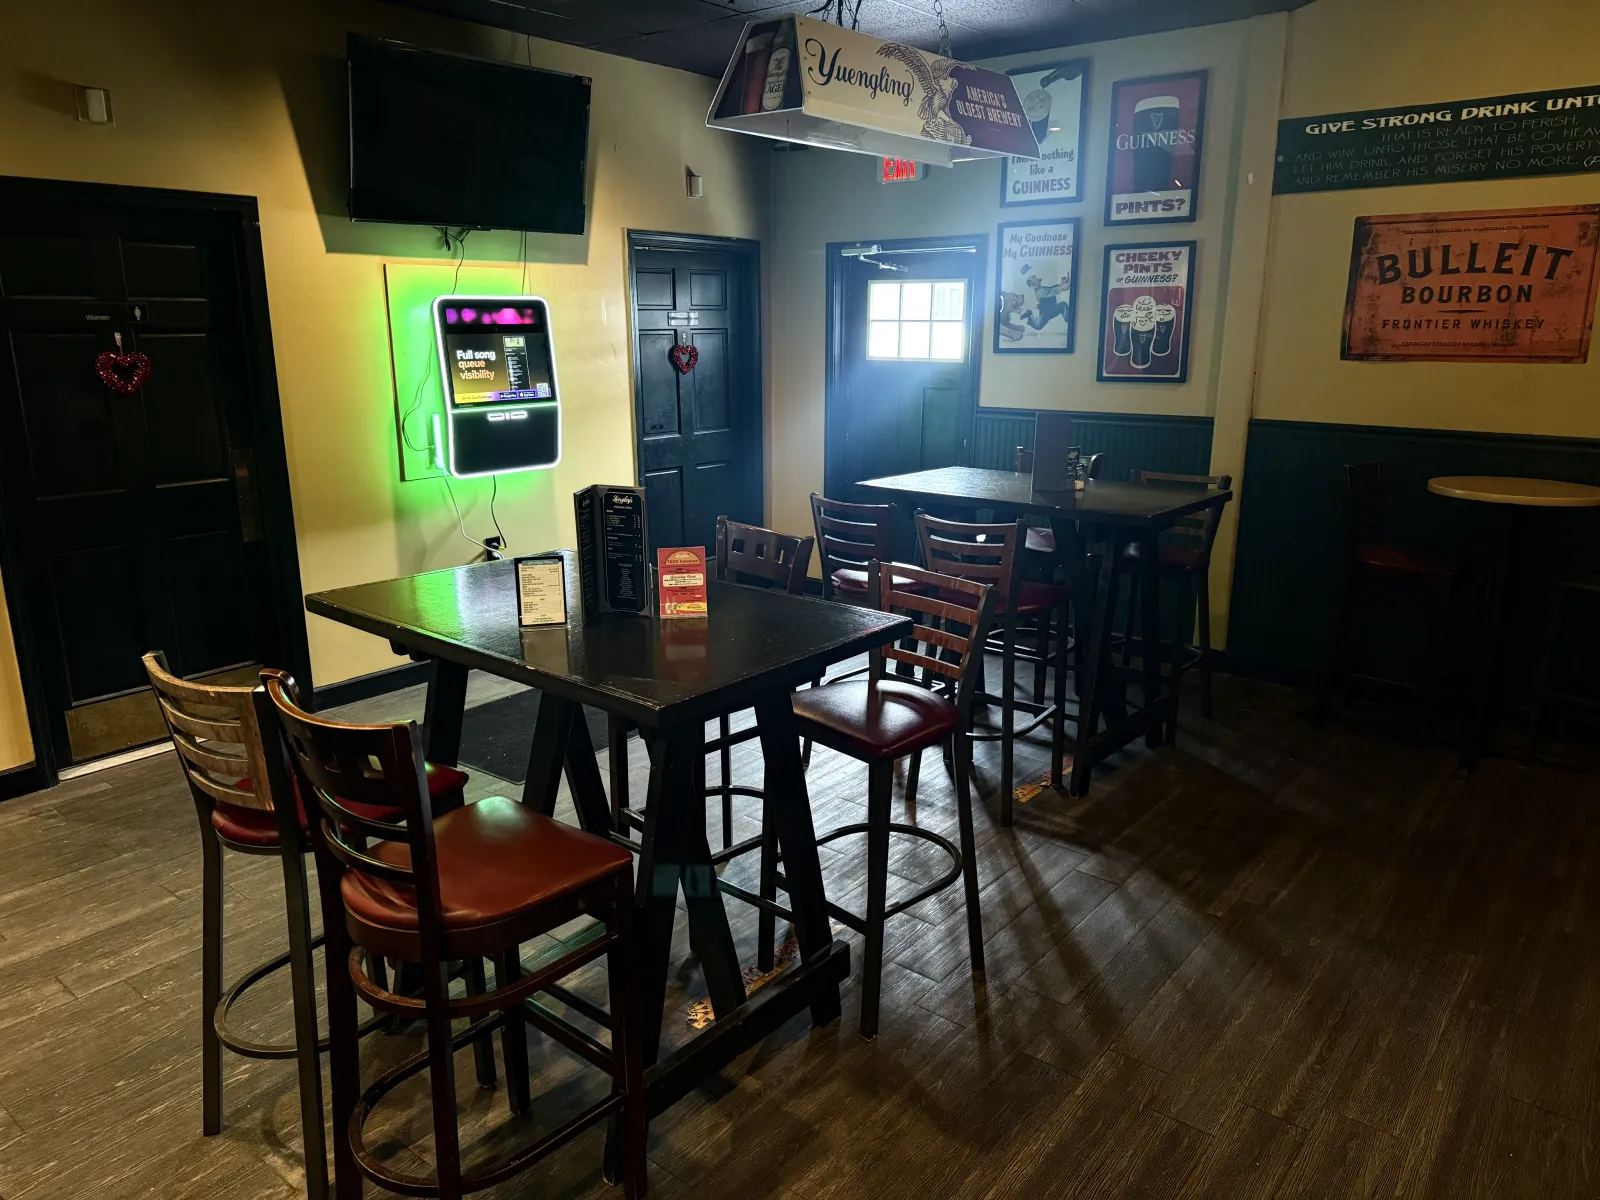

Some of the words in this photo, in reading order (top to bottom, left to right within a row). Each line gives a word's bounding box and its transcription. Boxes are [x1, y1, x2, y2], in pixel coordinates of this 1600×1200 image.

[805, 38, 914, 106] Yuengling
[966, 86, 1007, 108] AMERICA'S
[956, 100, 988, 119] OLDEST
[988, 106, 1021, 127] BREWERY
[1305, 120, 1355, 135] GIVE
[1361, 110, 1452, 130] STRONG
[1460, 101, 1540, 120] DRINK
[1116, 127, 1196, 151] GUINNESS
[1380, 130, 1414, 142] THAT
[1417, 128, 1431, 139] IS
[1436, 123, 1488, 137] READY
[1493, 120, 1516, 132] TO
[1295, 150, 1322, 162] AND
[1364, 143, 1405, 155] UNTO
[1412, 139, 1459, 151] THOSE
[1467, 135, 1499, 147] THAT
[1507, 132, 1526, 143] BE
[1531, 129, 1556, 141] OF
[1041, 148, 1074, 164] nothing
[1293, 163, 1314, 174] LET
[1320, 161, 1344, 172] HIM
[1398, 154, 1428, 165] AND
[1434, 148, 1493, 161] FORGET
[1500, 145, 1525, 157] HIS
[1029, 163, 1046, 176] like
[1047, 165, 1054, 175] a
[1293, 175, 1320, 186] AND
[1325, 168, 1401, 184] REMEMBER
[1406, 166, 1428, 177] HIS
[1434, 162, 1489, 175] MISERY
[1495, 159, 1521, 170] NO
[1012, 177, 1071, 196] GUINNESS
[1115, 197, 1186, 215] PINTS?
[1010, 233, 1023, 246] My
[1025, 232, 1068, 243] Goodness
[1003, 247, 1018, 260] My
[1019, 244, 1073, 258] GUINNESS
[1115, 250, 1183, 264] CHEEKY
[1123, 262, 1173, 274] PINTS
[1375, 242, 1574, 286] BULLEIT
[1124, 272, 1179, 285] GUINNESS?
[1401, 284, 1534, 305] BOURBON
[85, 313, 111, 321] Women
[1382, 318, 1462, 331] FRONTIER
[1470, 318, 1546, 330] WHISKEY
[456, 350, 474, 360] Full
[474, 350, 496, 361] song
[458, 360, 486, 369] queue
[460, 369, 495, 381] visibility
